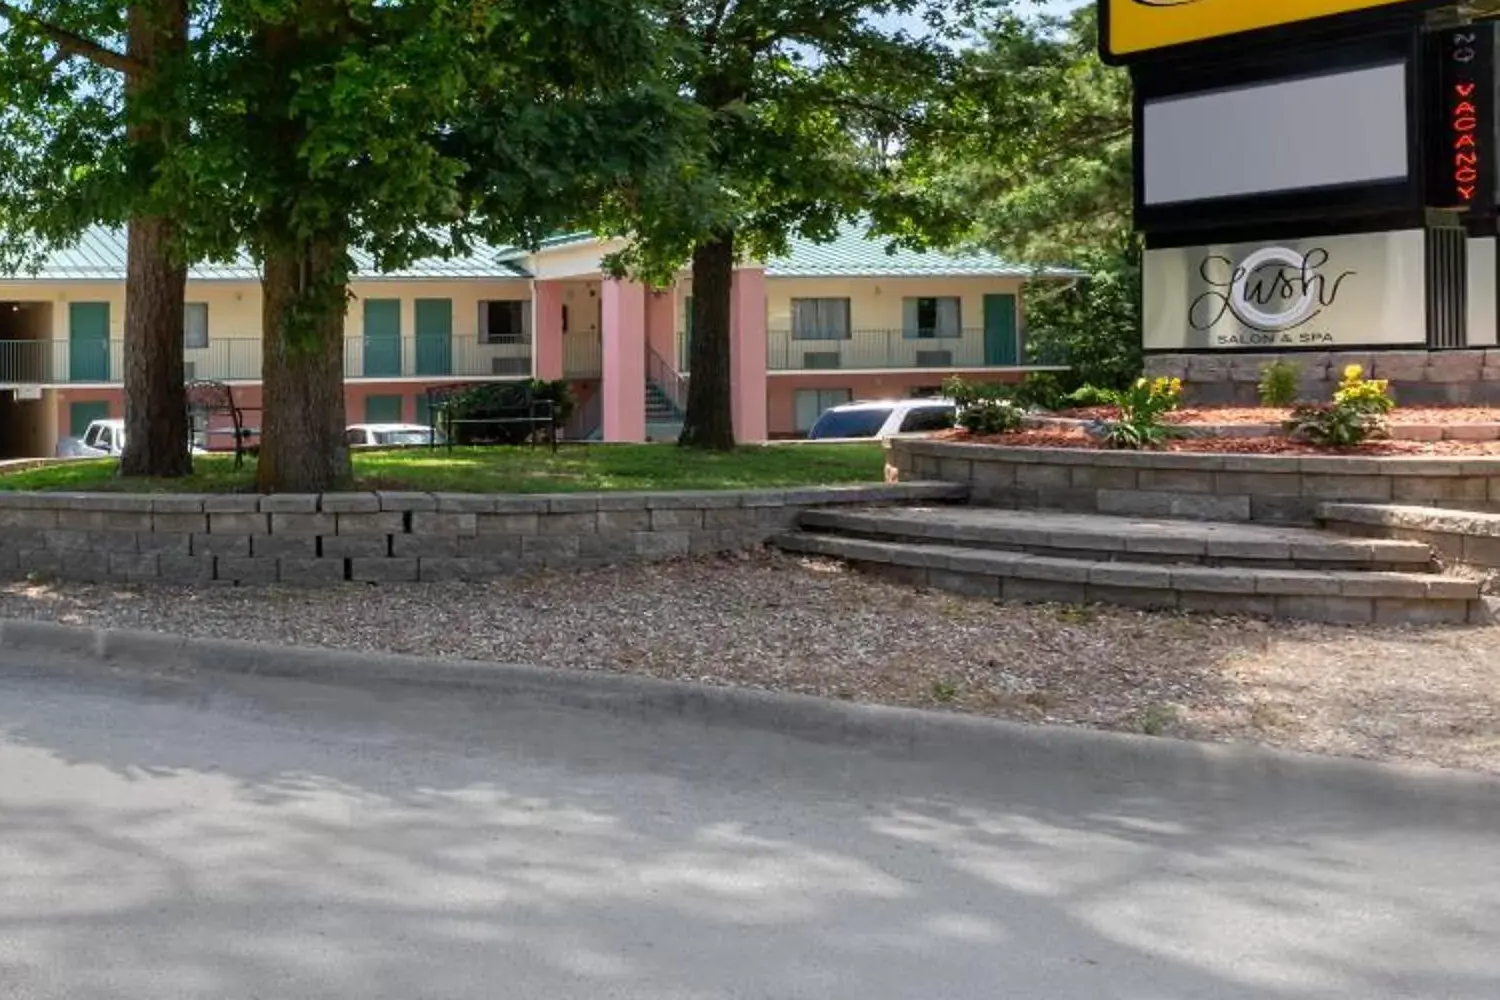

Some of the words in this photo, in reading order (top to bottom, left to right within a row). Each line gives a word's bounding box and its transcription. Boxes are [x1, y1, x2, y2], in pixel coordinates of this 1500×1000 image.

[1453, 83, 1477, 200] VACANCY
[1188, 247, 1357, 332] Lush
[1217, 333, 1275, 344] SALON
[1280, 333, 1293, 343] &
[1299, 332, 1333, 343] SPA
